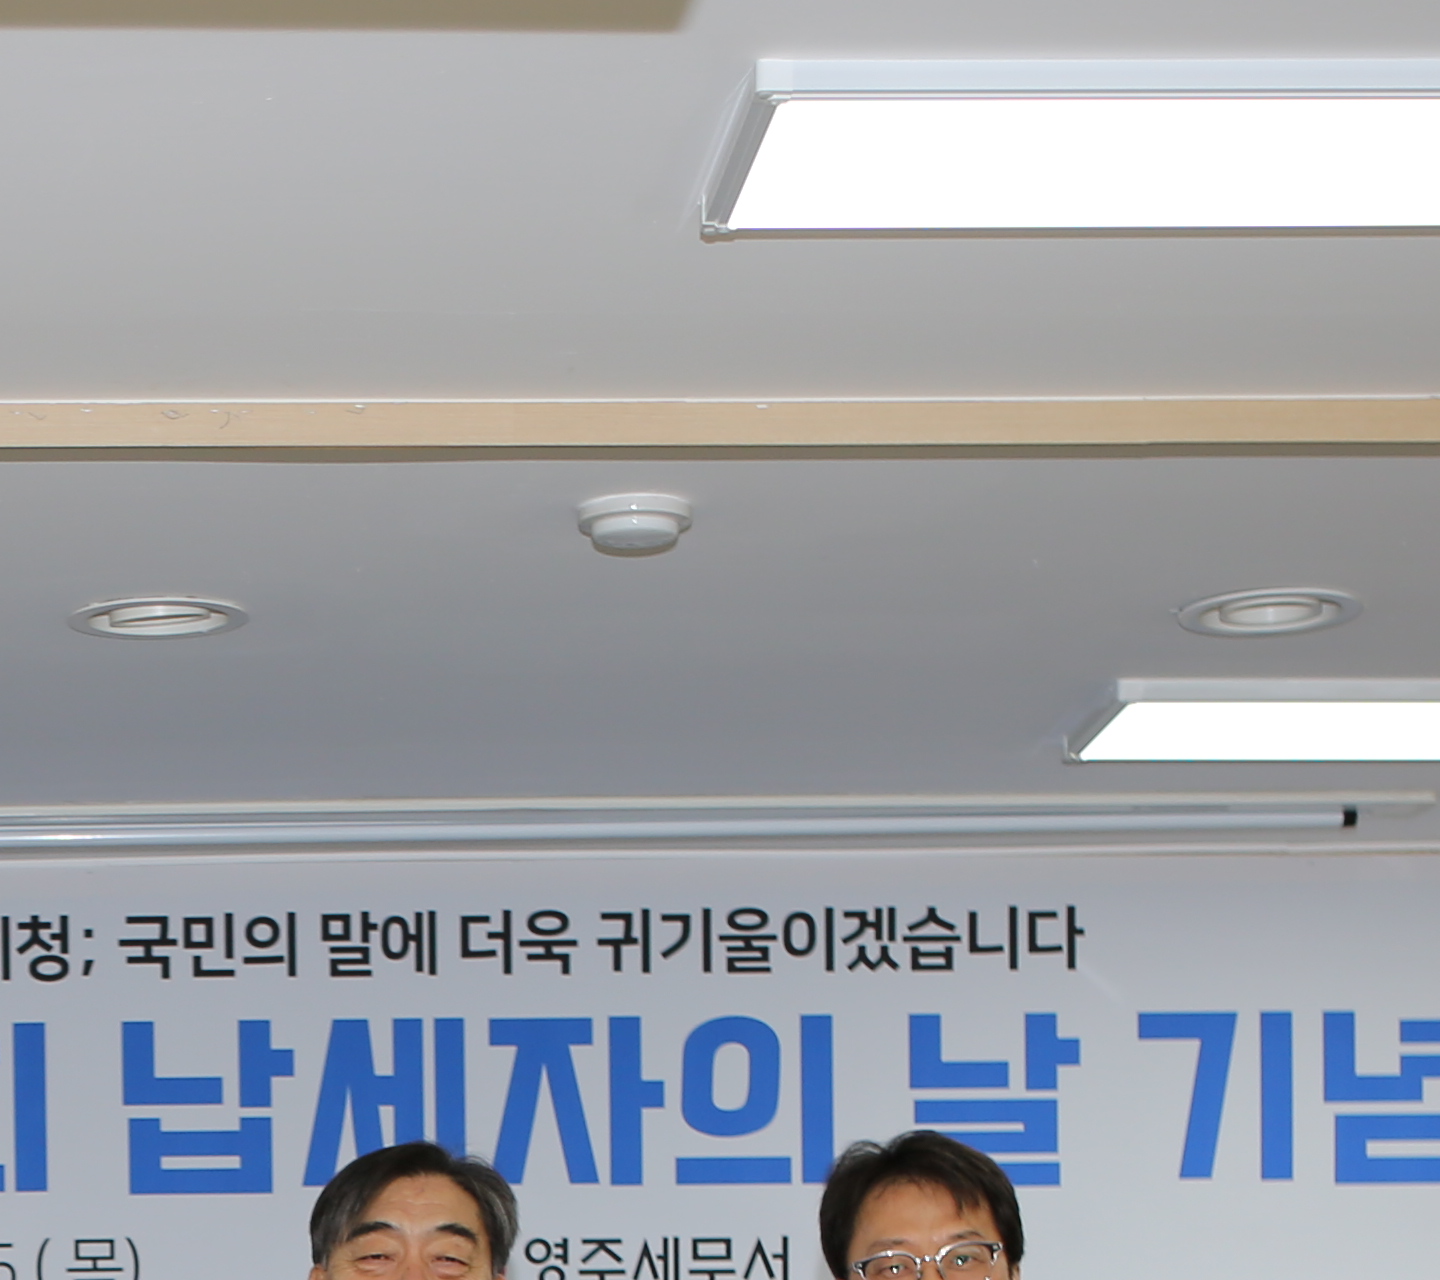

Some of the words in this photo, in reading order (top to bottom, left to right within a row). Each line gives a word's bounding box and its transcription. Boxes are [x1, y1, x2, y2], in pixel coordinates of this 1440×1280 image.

[117, 910, 299, 981] 국민의
[320, 909, 439, 979] 말에
[459, 908, 579, 976] 더욱
[596, 904, 1086, 975] 귀기울이겠습니다
[121, 1013, 836, 1195] 납세자의
[908, 1012, 1082, 1187] 날
